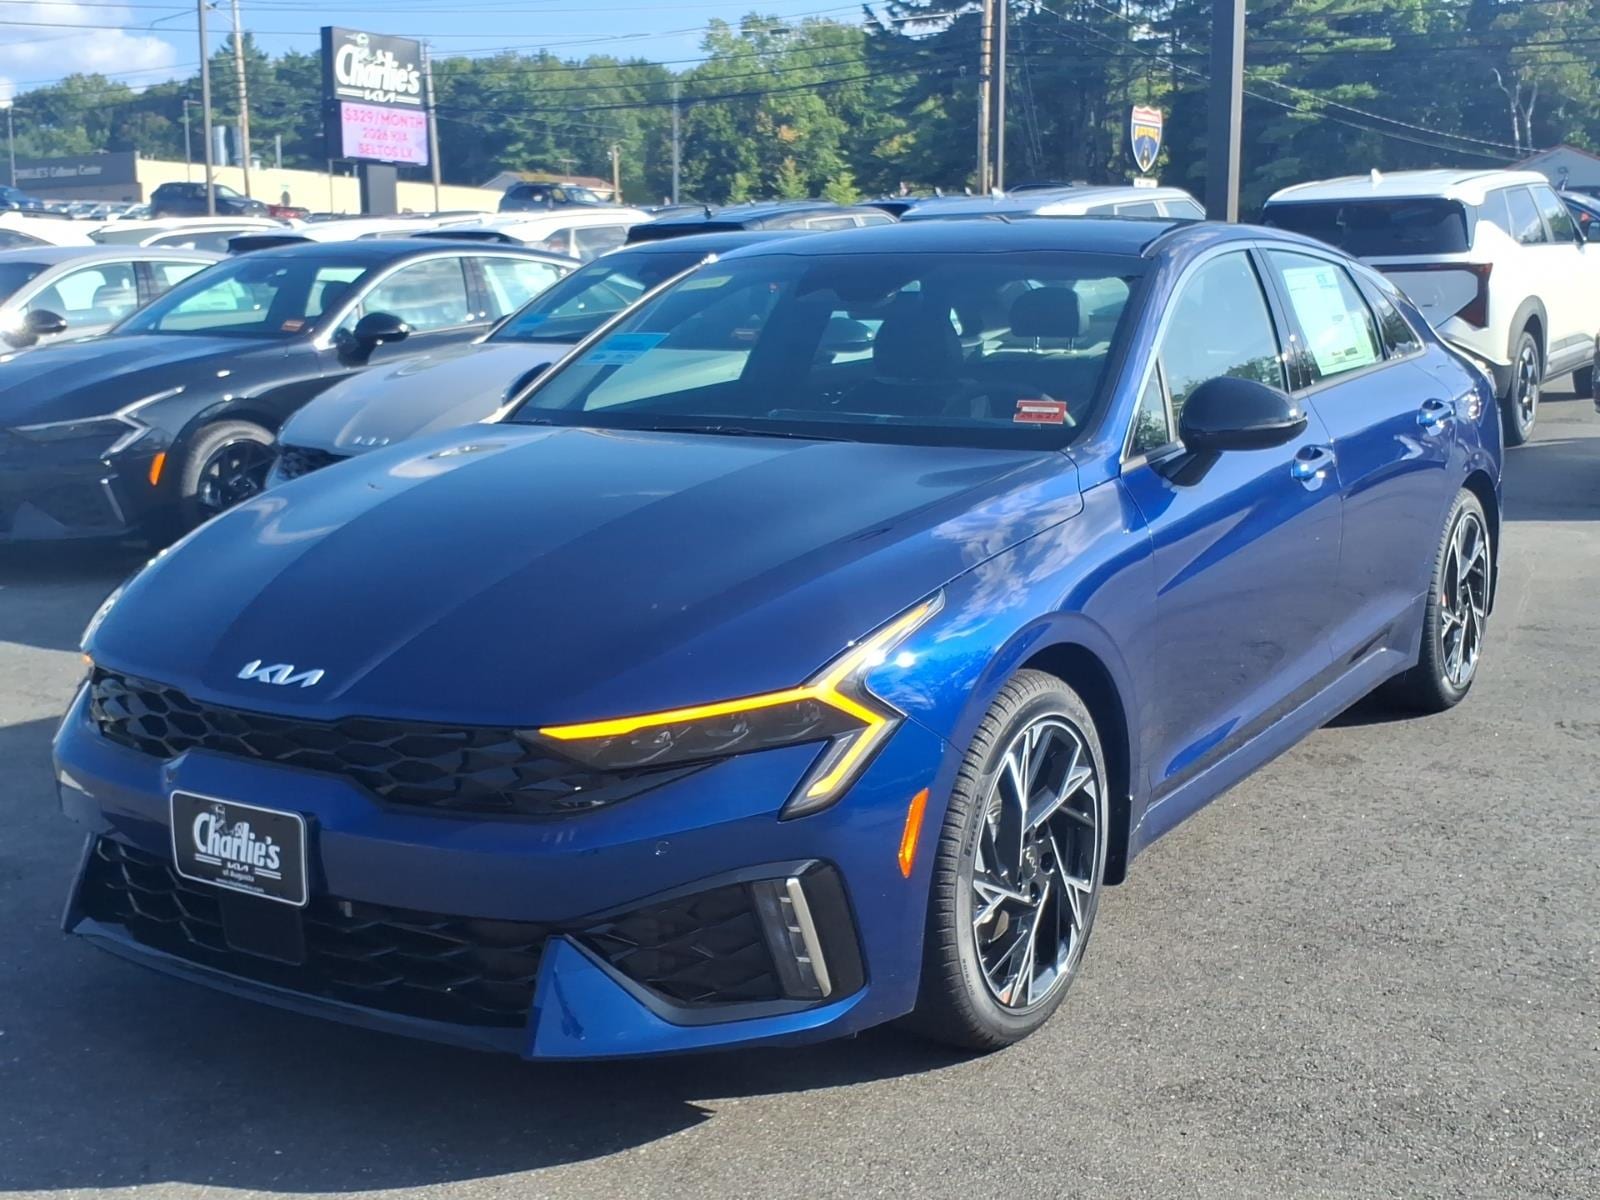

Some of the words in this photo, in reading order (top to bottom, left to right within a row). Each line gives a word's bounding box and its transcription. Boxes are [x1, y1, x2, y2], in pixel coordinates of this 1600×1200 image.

[335, 43, 420, 94] Charlie's
[344, 107, 424, 129] $329/MONTH
[359, 142, 398, 156] SELTOS
[237, 659, 325, 688] KIA
[193, 812, 280, 869] Charlie's
